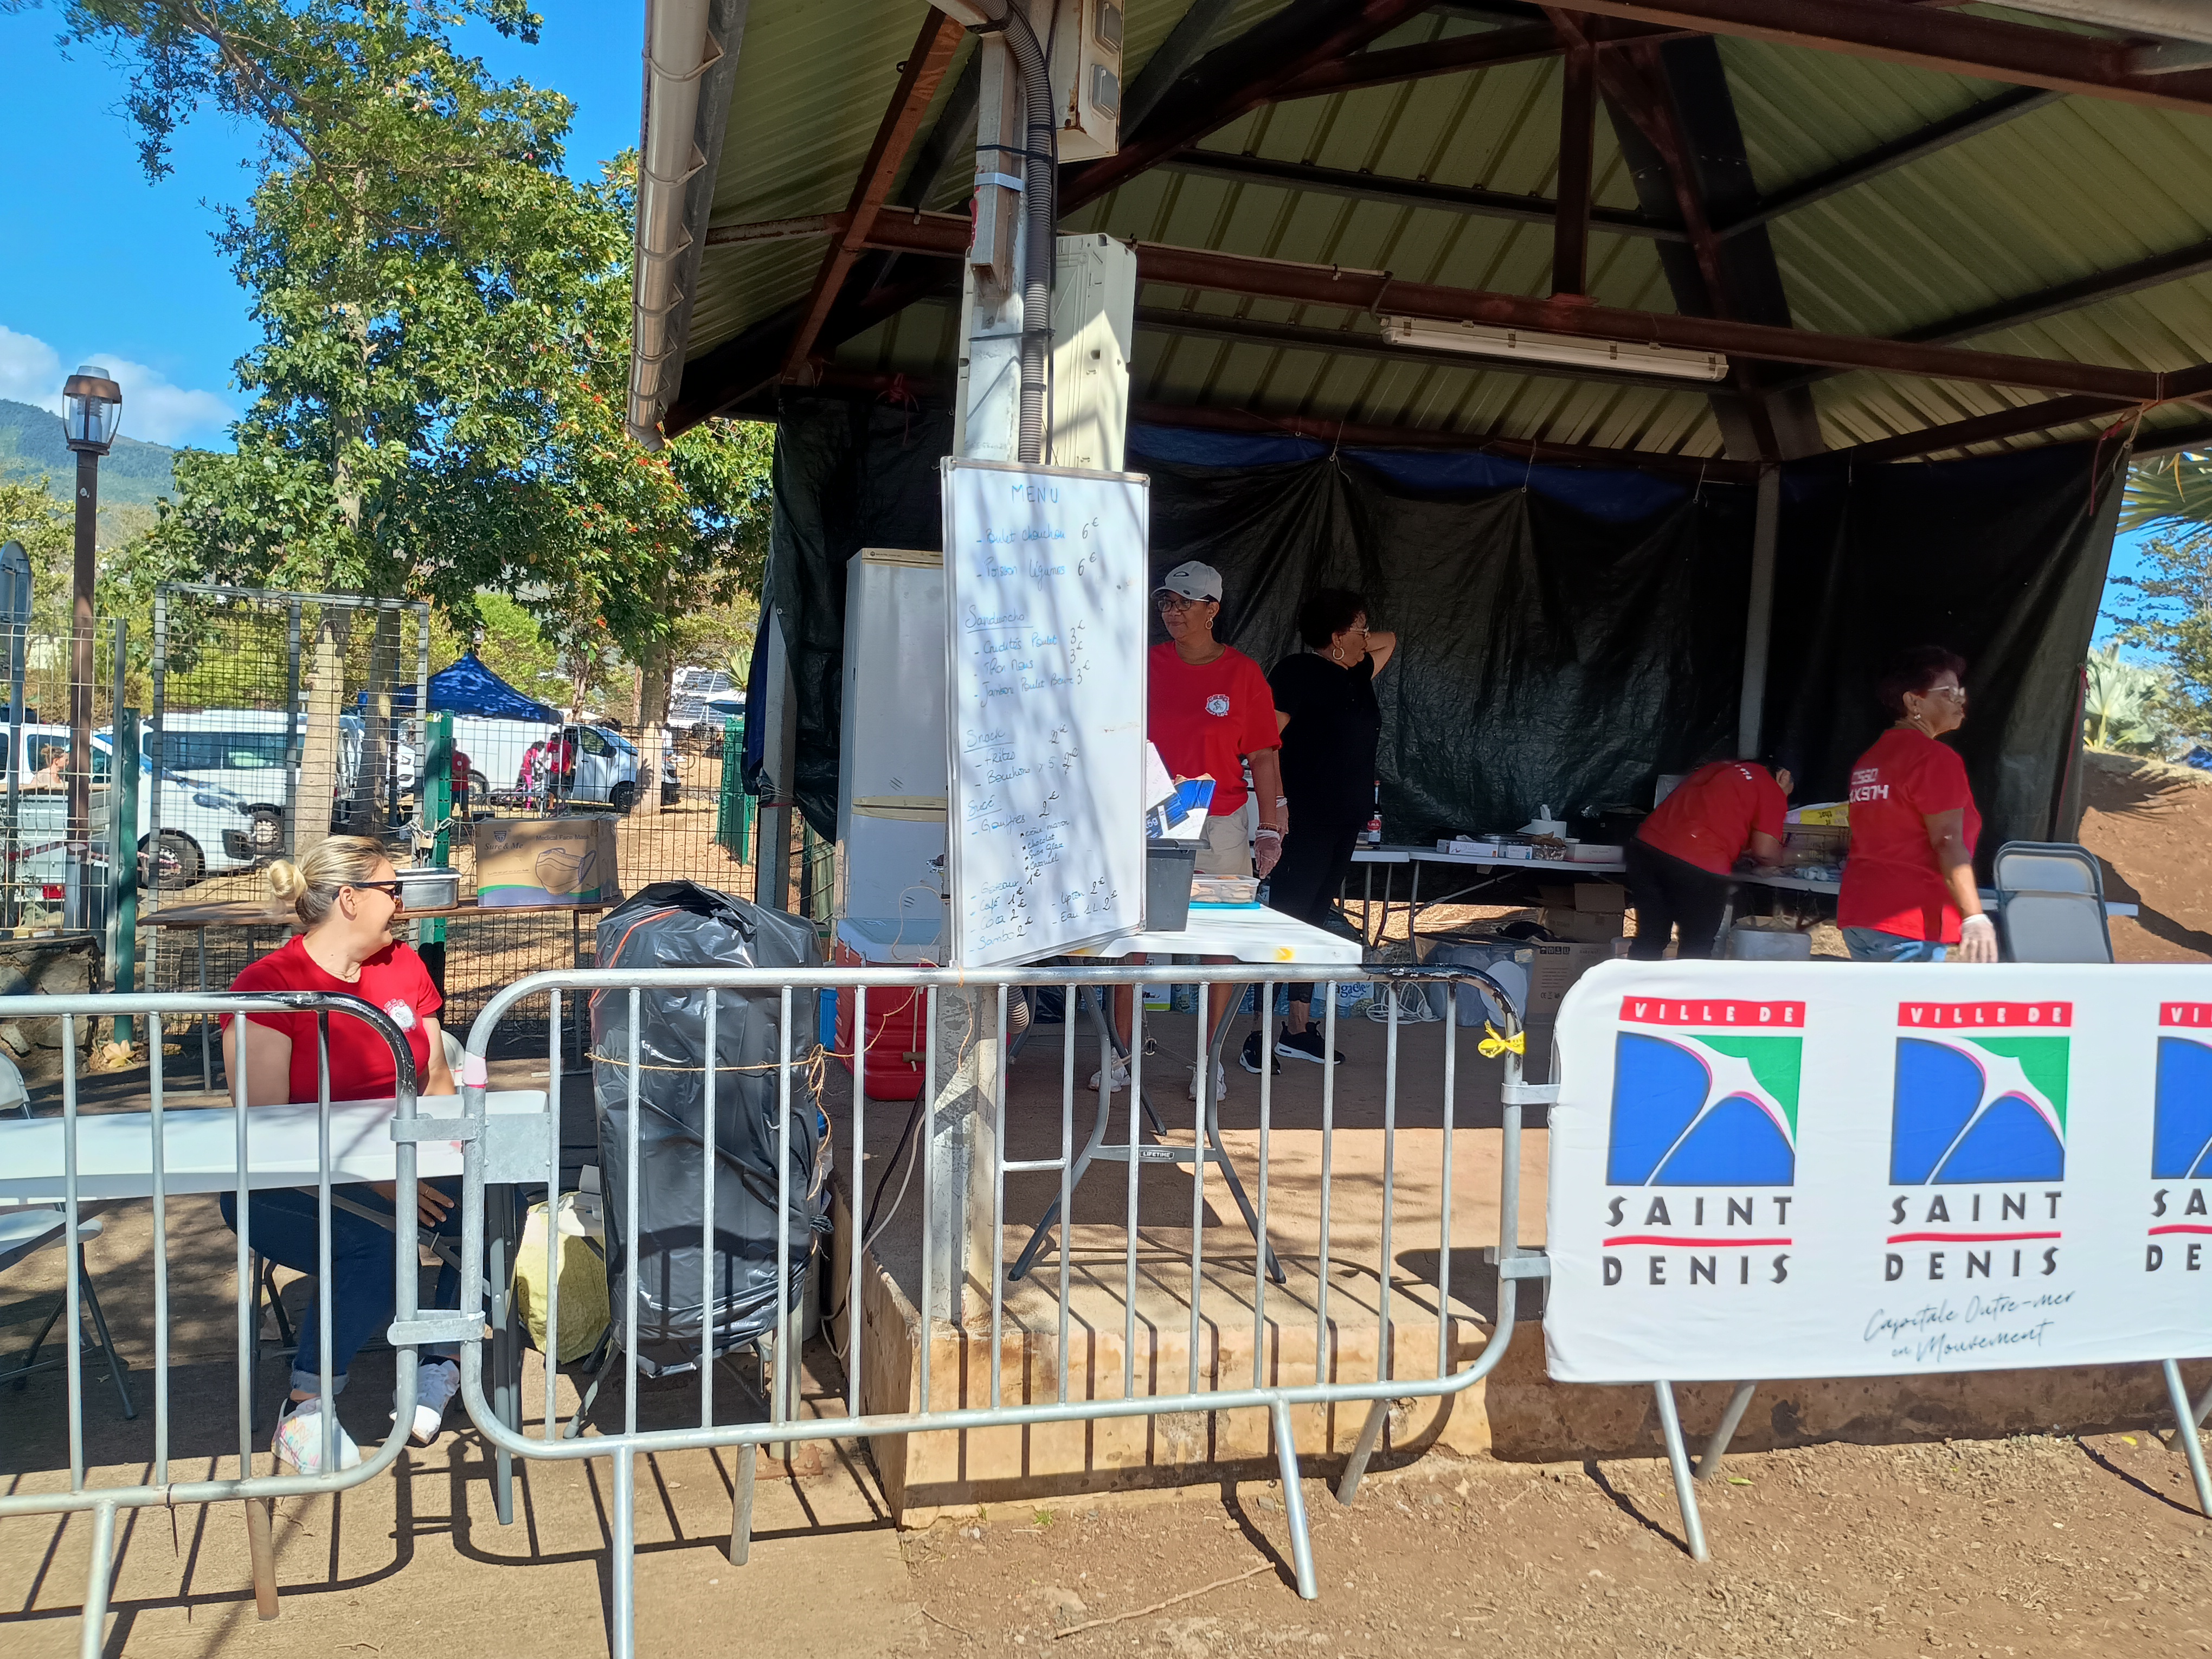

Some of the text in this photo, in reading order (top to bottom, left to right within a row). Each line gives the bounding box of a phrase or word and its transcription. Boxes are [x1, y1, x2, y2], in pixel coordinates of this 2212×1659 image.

[1012, 484, 1059, 503] MENU
[986, 528, 1016, 544] Poulet
[984, 556, 1018, 577] Poisson
[983, 638, 1022, 654] Crudités
[1032, 632, 1057, 647] Poulet
[985, 658, 1005, 676] Thon
[980, 681, 1014, 708] Jambon
[1021, 677, 1045, 692] Poulet
[967, 728, 1005, 747] Snack
[1146, 818, 1158, 829] 5g
[980, 896, 1000, 914] Café
[980, 915, 1006, 930] Coca
[1061, 911, 1080, 922] Eau
[1635, 1002, 1794, 1023] VILLE DE
[1911, 1007, 2062, 1024] VILLE DE
[2170, 1006, 2212, 1023] VI
[1605, 1195, 1792, 1227] SAINT
[1889, 1191, 2062, 1225] SAINT
[1602, 1253, 1791, 1287] DENIS
[1885, 1245, 2060, 1282] DENIS
[1864, 1290, 2075, 1341] Capitale Outre-mer
[1892, 1318, 2054, 1362] en Mouvement
